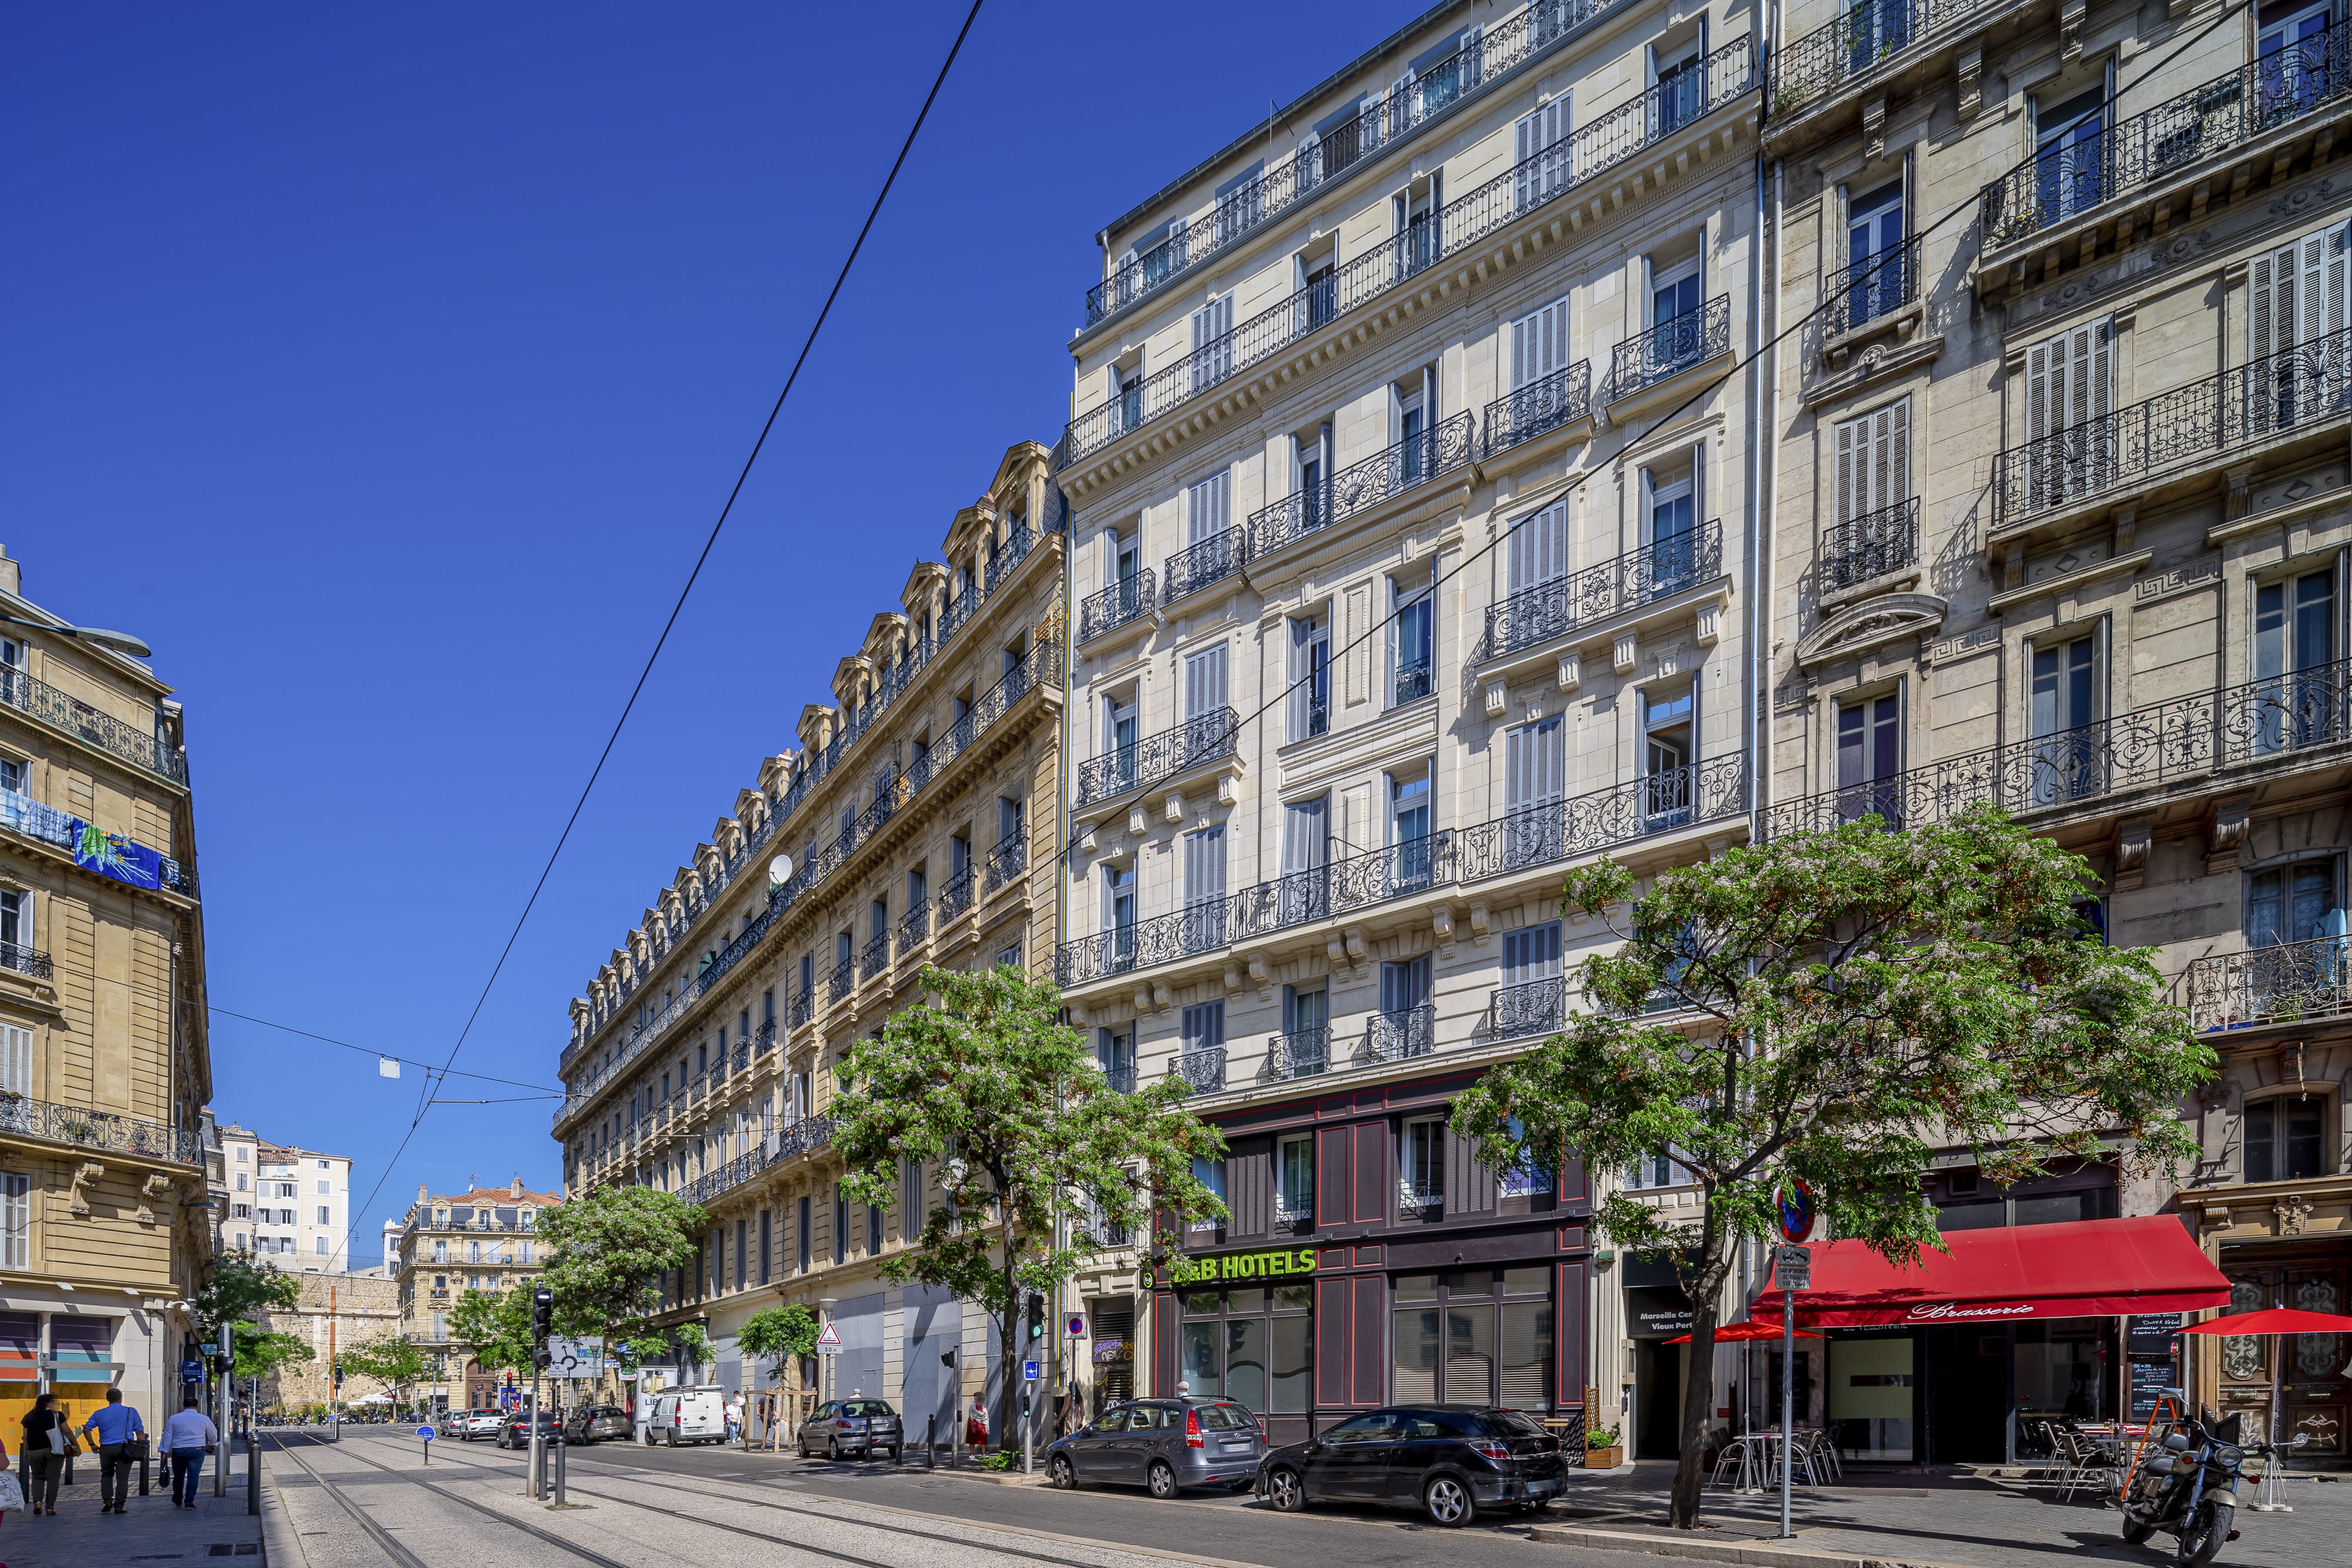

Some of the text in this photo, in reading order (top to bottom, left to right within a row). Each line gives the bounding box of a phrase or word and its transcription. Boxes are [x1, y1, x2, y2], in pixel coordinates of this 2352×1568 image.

[1174, 1249, 1316, 1283] &B HOTELS
[1641, 1312, 1676, 1320] Marseille
[1907, 1301, 2034, 1320] Brasserie
